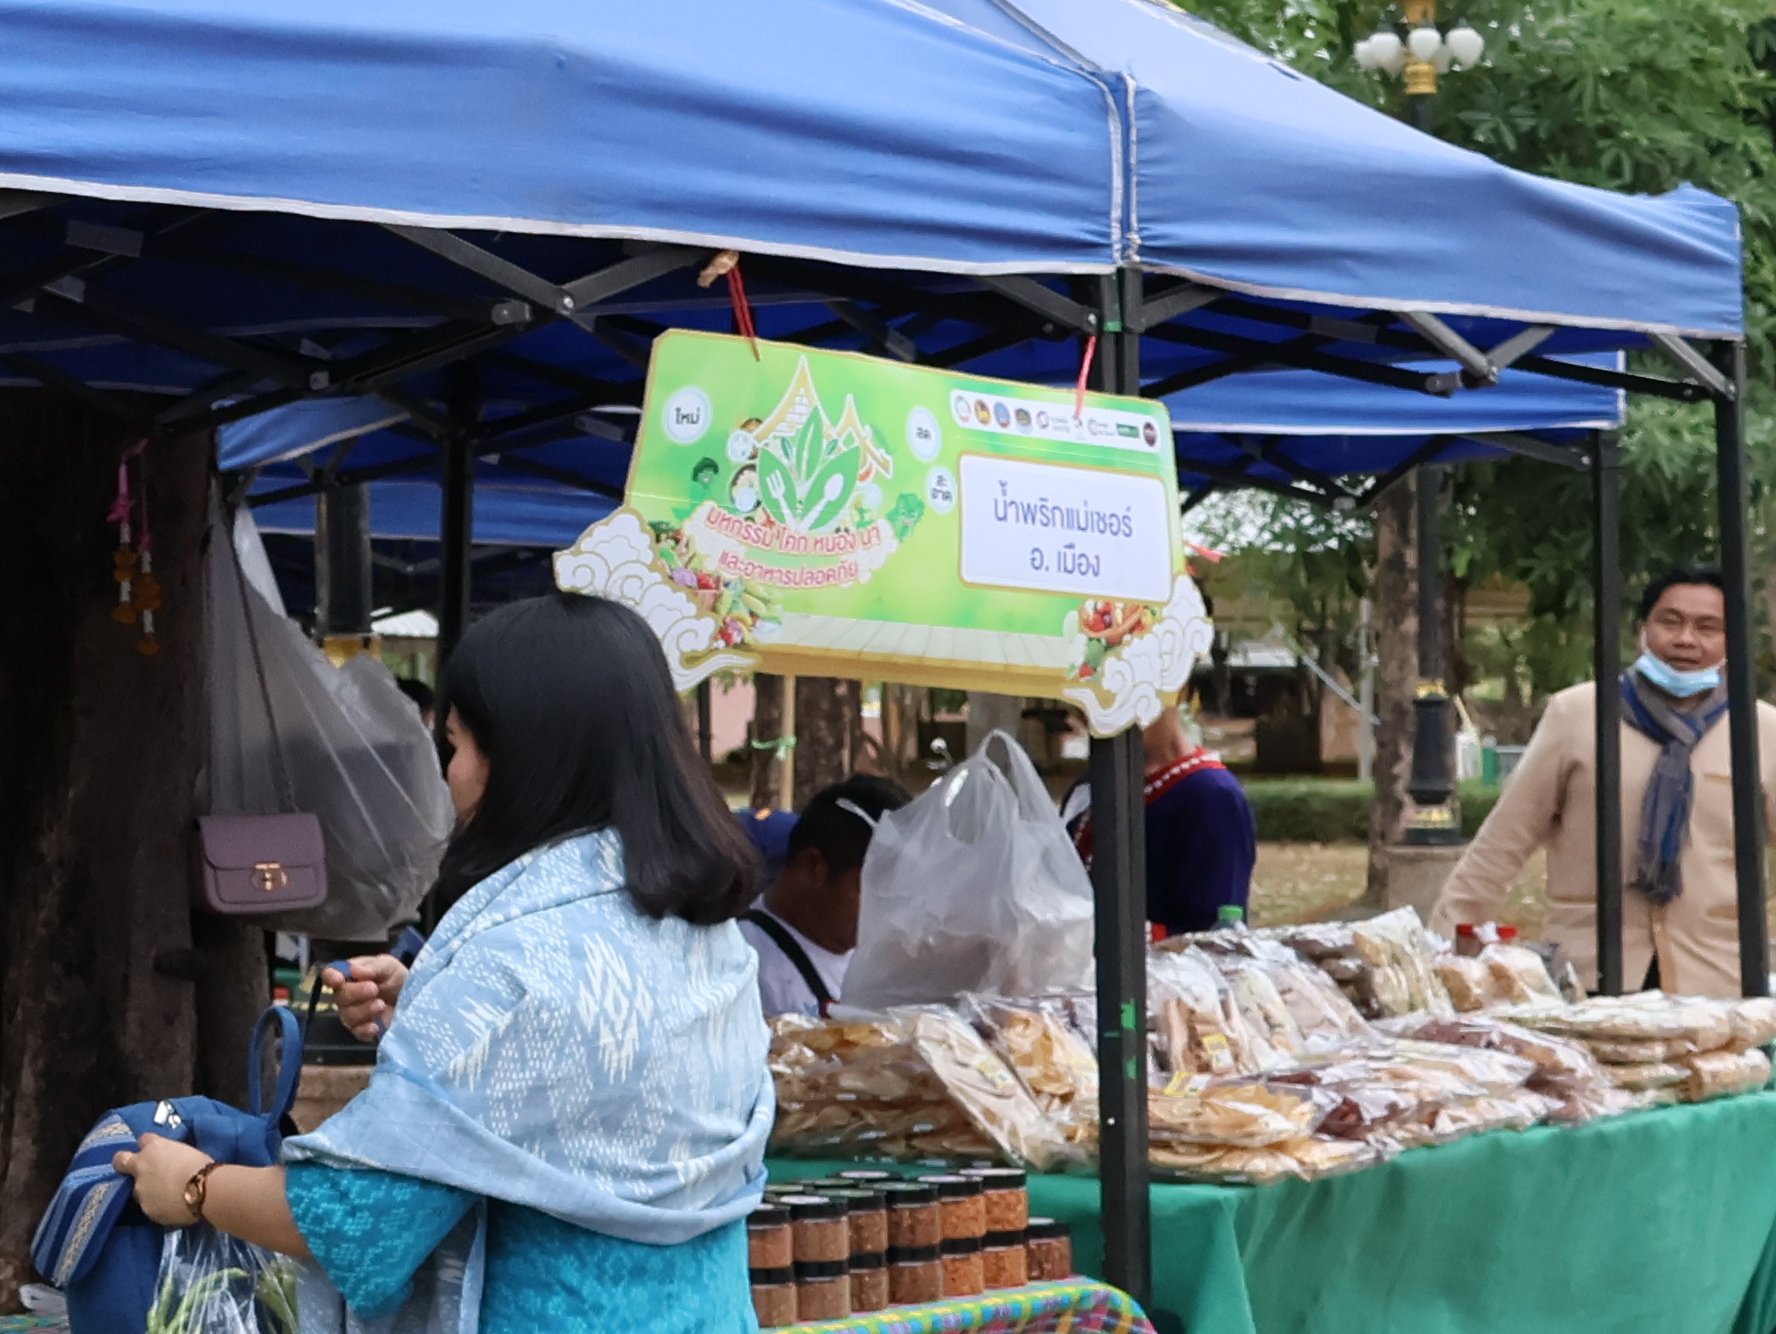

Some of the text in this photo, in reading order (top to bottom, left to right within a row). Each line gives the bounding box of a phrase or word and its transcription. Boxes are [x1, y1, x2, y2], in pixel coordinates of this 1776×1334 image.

[674, 407, 701, 425] ใหม่
[705, 507, 773, 548] มหกรรม
[993, 479, 1134, 538] น้ำพริกแม่เชอร์
[1030, 542, 1100, 577] อ. เมือง
